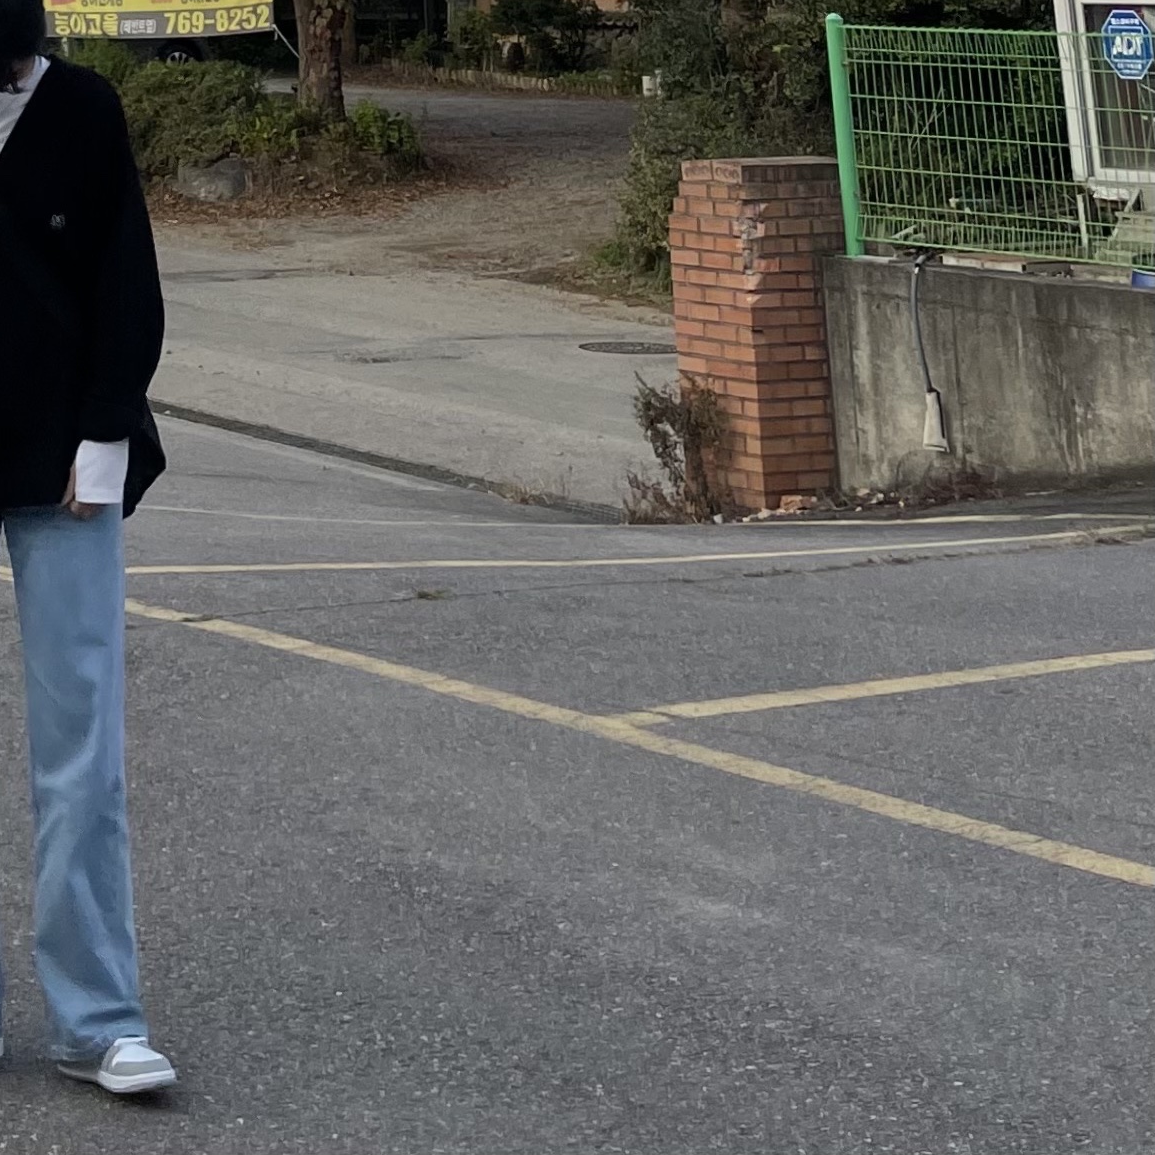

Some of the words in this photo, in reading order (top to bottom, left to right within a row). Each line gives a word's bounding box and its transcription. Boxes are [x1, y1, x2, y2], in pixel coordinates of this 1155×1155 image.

[54, 12, 119, 36] 능이고을
[164, 5, 271, 34] 769-8252
[1113, 32, 1143, 56] ADT
